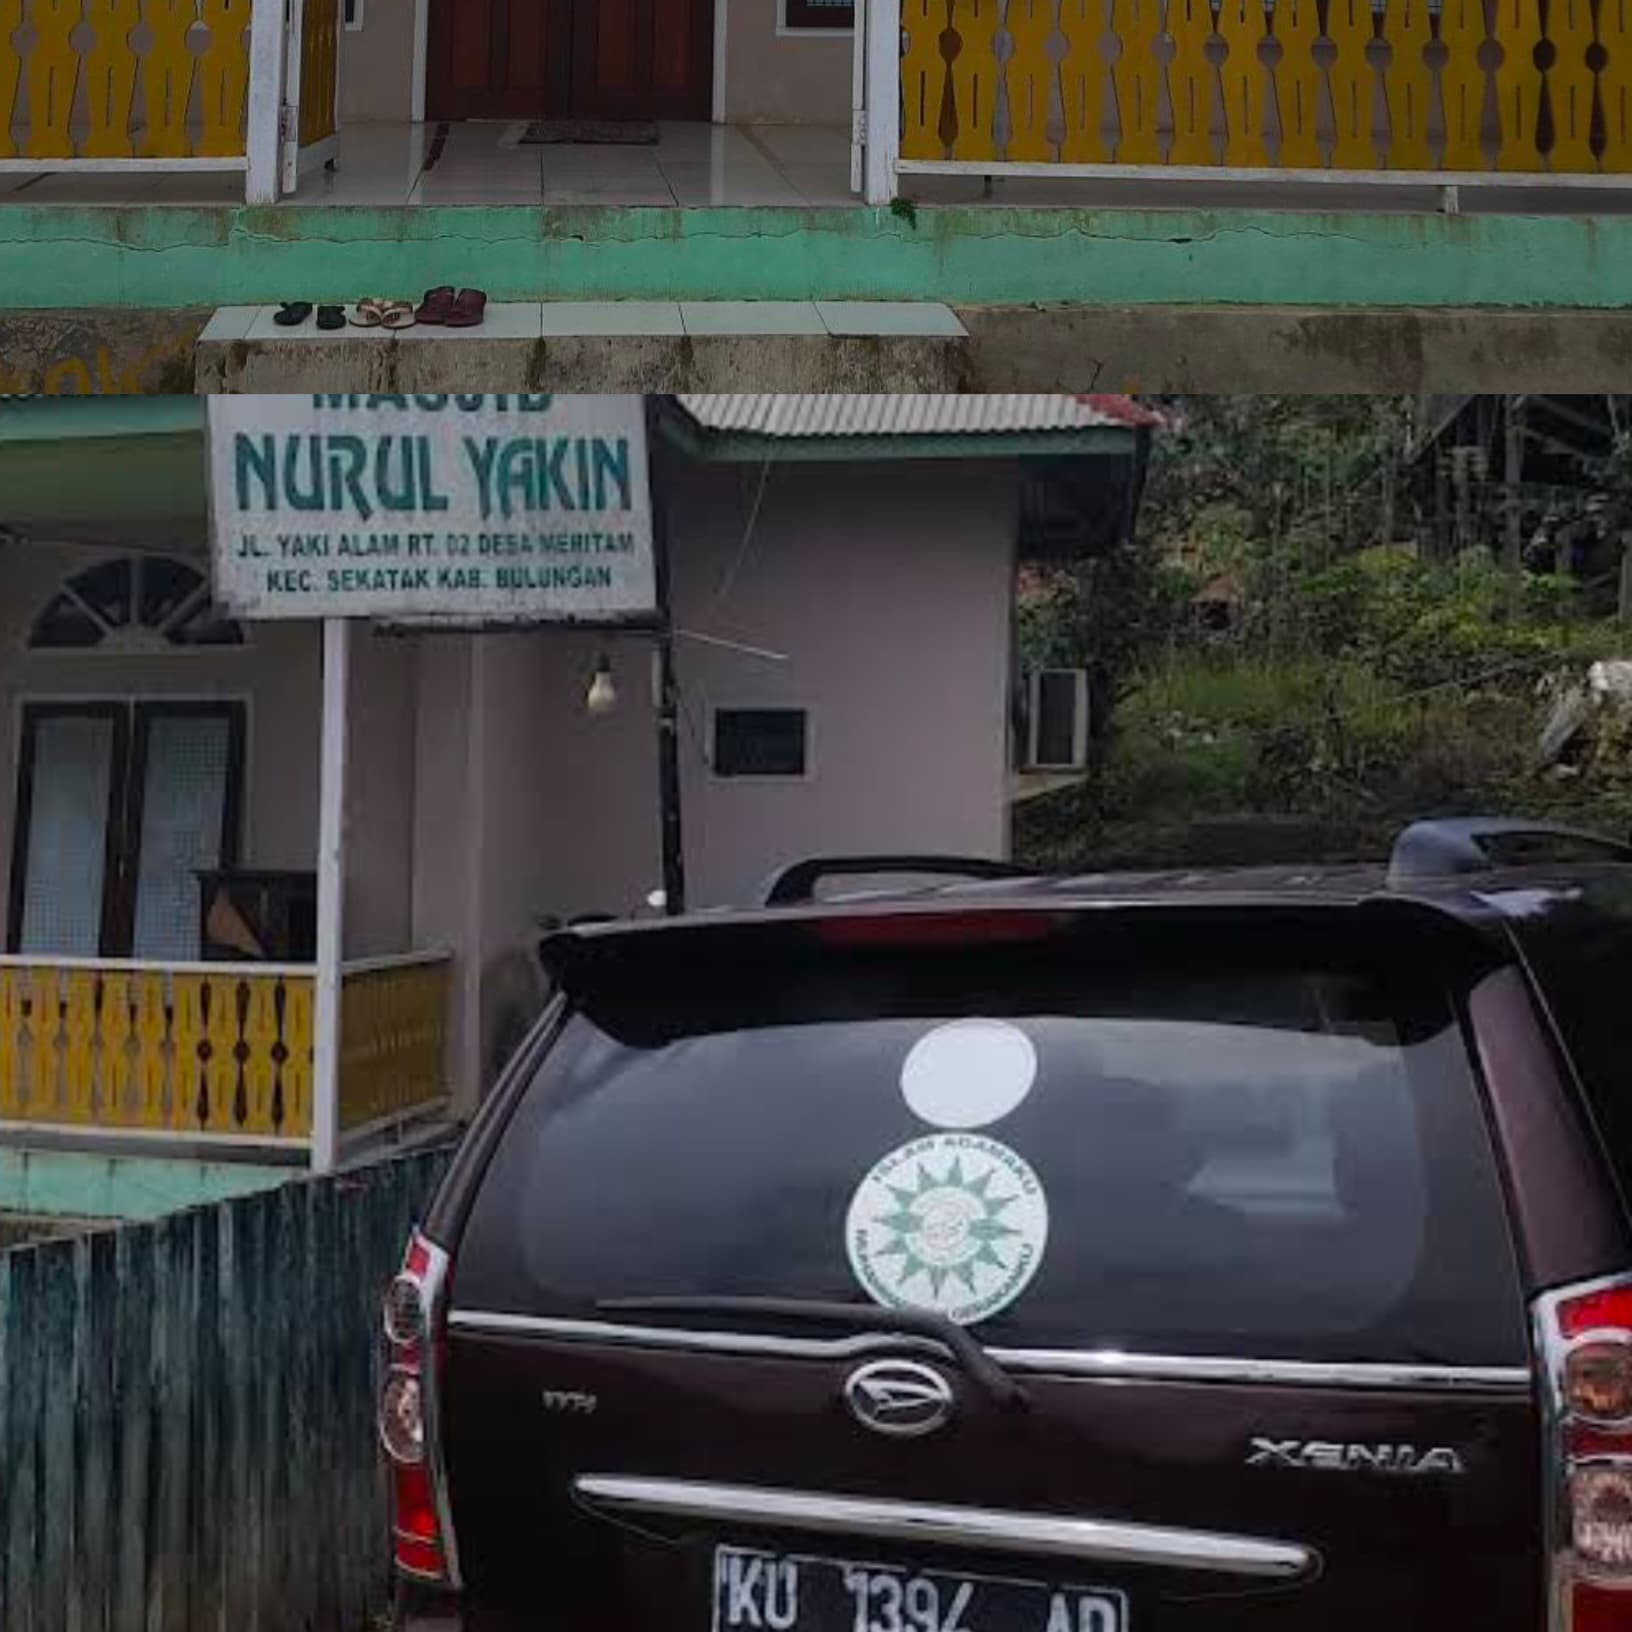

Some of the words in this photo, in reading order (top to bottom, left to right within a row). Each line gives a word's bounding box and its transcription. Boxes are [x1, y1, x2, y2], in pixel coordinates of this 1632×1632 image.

[234, 432, 449, 522] NURUL
[463, 436, 632, 521] YAKIN
[277, 534, 329, 558] YAKI
[338, 533, 399, 556] ALAM
[479, 534, 533, 555] DESA
[327, 569, 430, 591] SEKATAK
[496, 567, 611, 589] BULUNGAN
[1245, 1437, 1466, 1473] XENIA
[727, 1556, 797, 1629] KU
